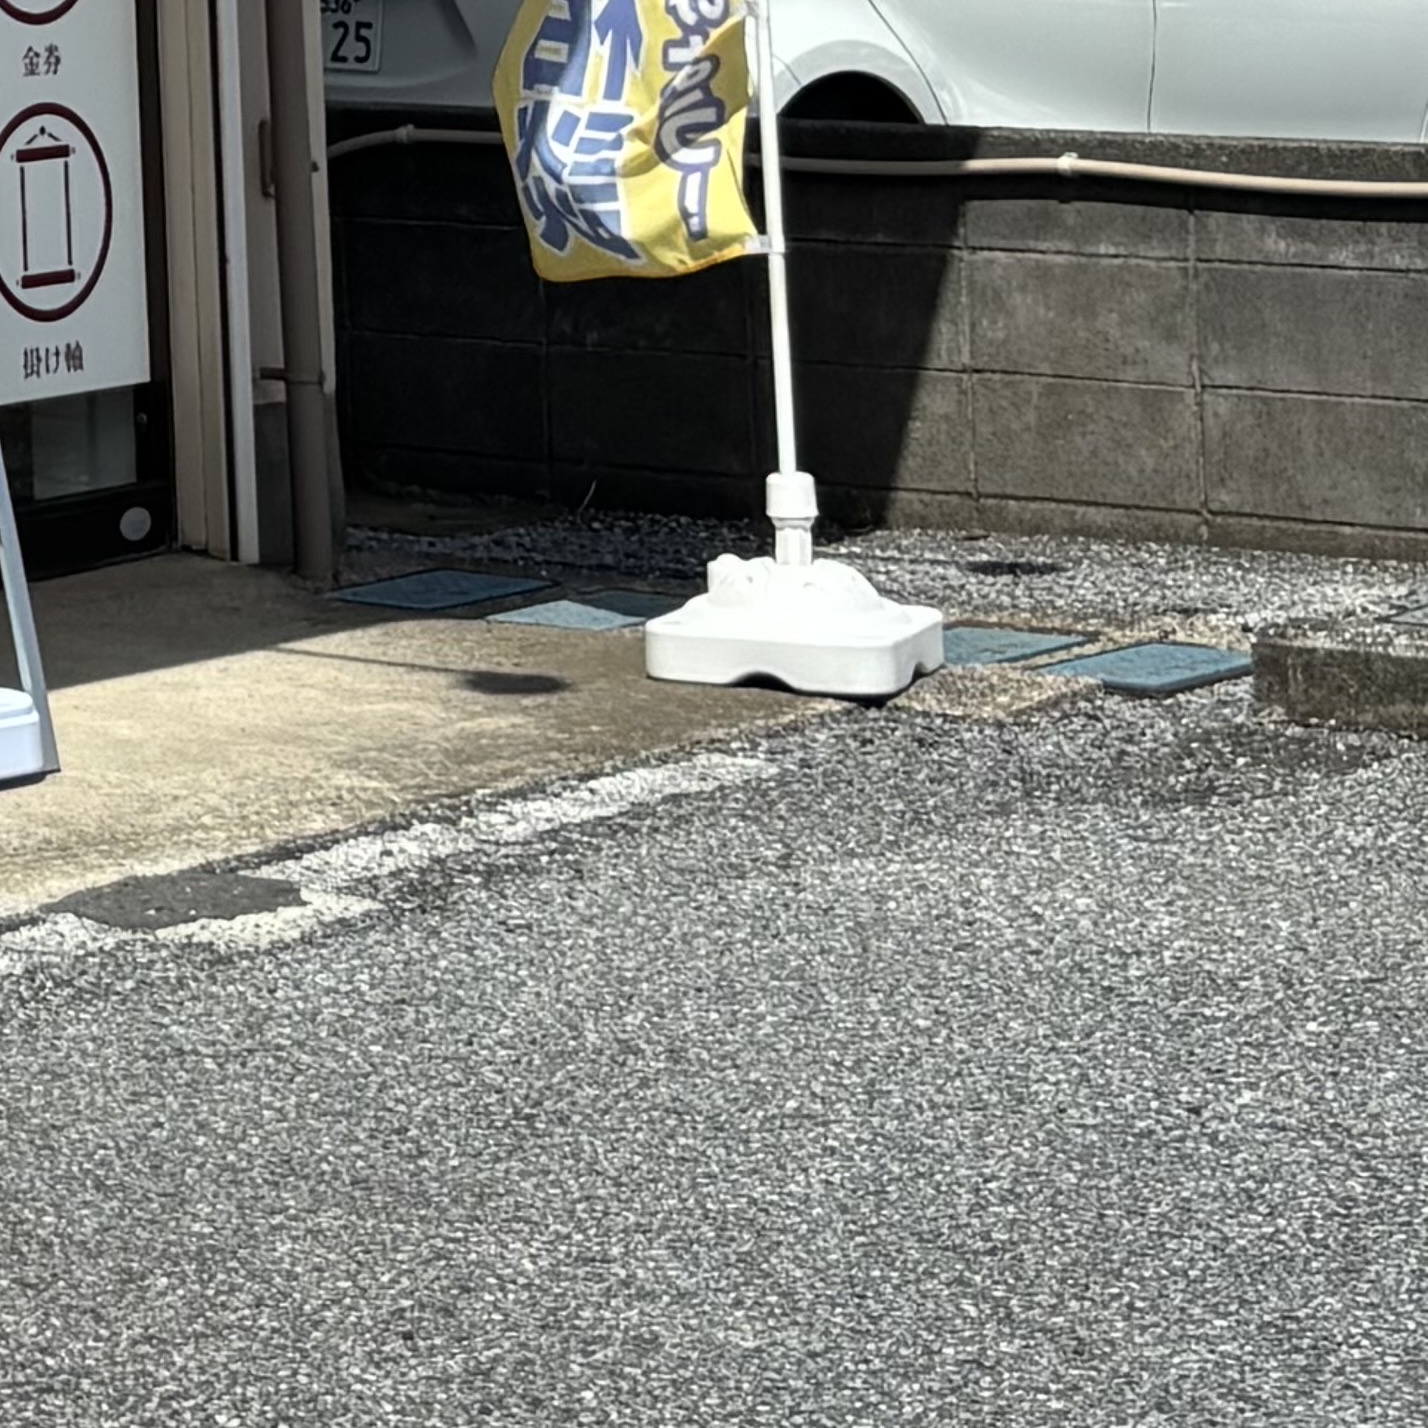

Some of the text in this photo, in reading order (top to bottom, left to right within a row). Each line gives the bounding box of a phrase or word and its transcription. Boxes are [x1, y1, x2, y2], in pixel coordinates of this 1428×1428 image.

[21, 44, 63, 78] 金券
[22, 343, 85, 380] 掛け軸
